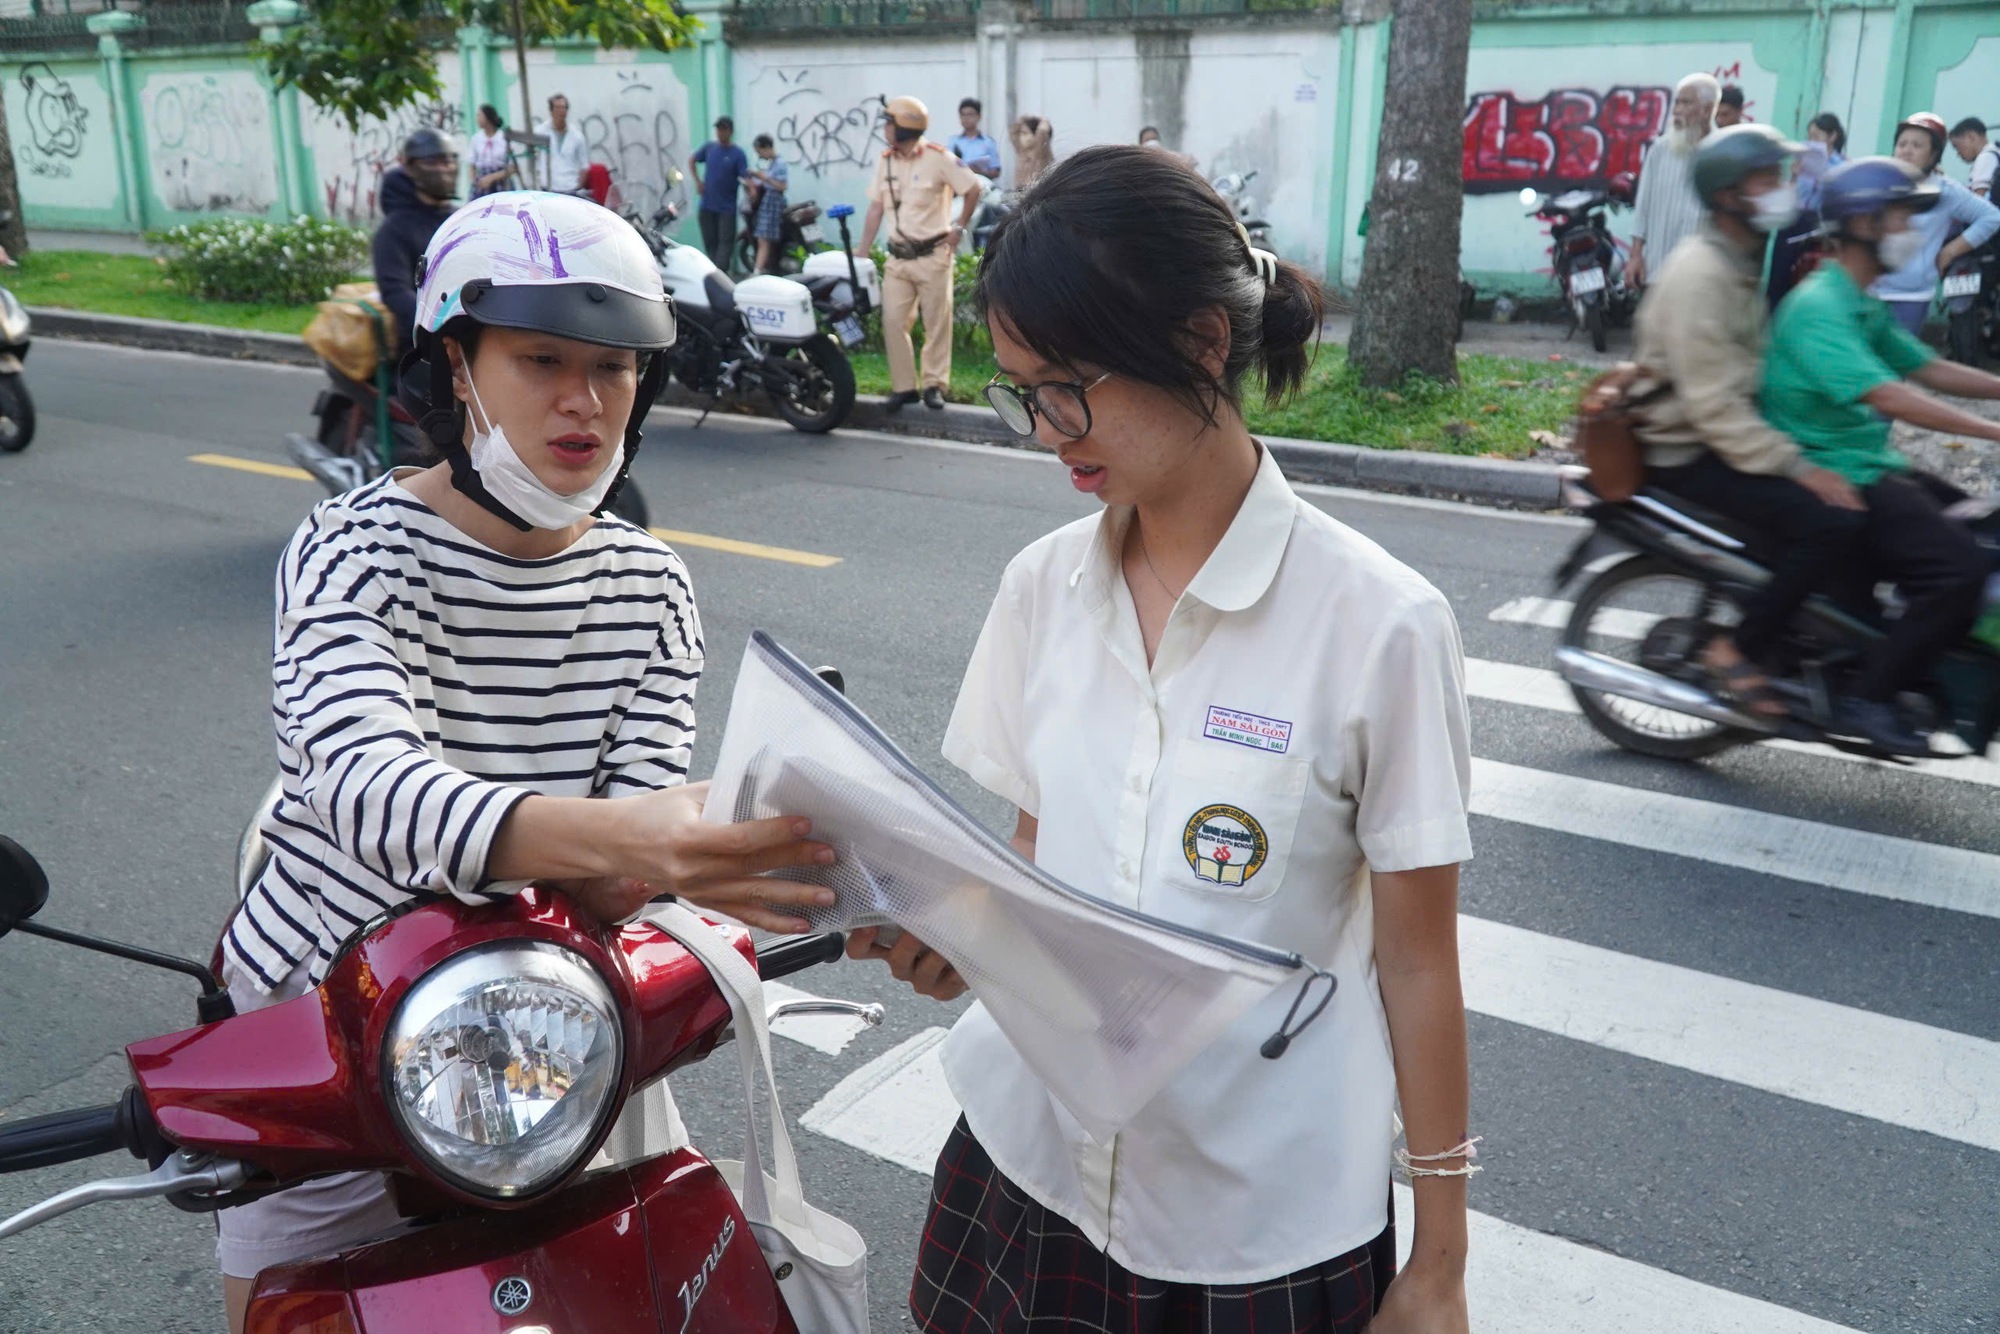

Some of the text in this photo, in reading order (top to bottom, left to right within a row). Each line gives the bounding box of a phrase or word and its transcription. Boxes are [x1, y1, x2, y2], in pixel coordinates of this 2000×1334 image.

[746, 306, 786, 322] CSGT
[1212, 715, 1237, 728] NAM
[1262, 727, 1287, 738] GÒN
[1228, 732, 1245, 741] MINH
[1216, 837, 1234, 848] SOUTH
[677, 1214, 735, 1334] Janus
